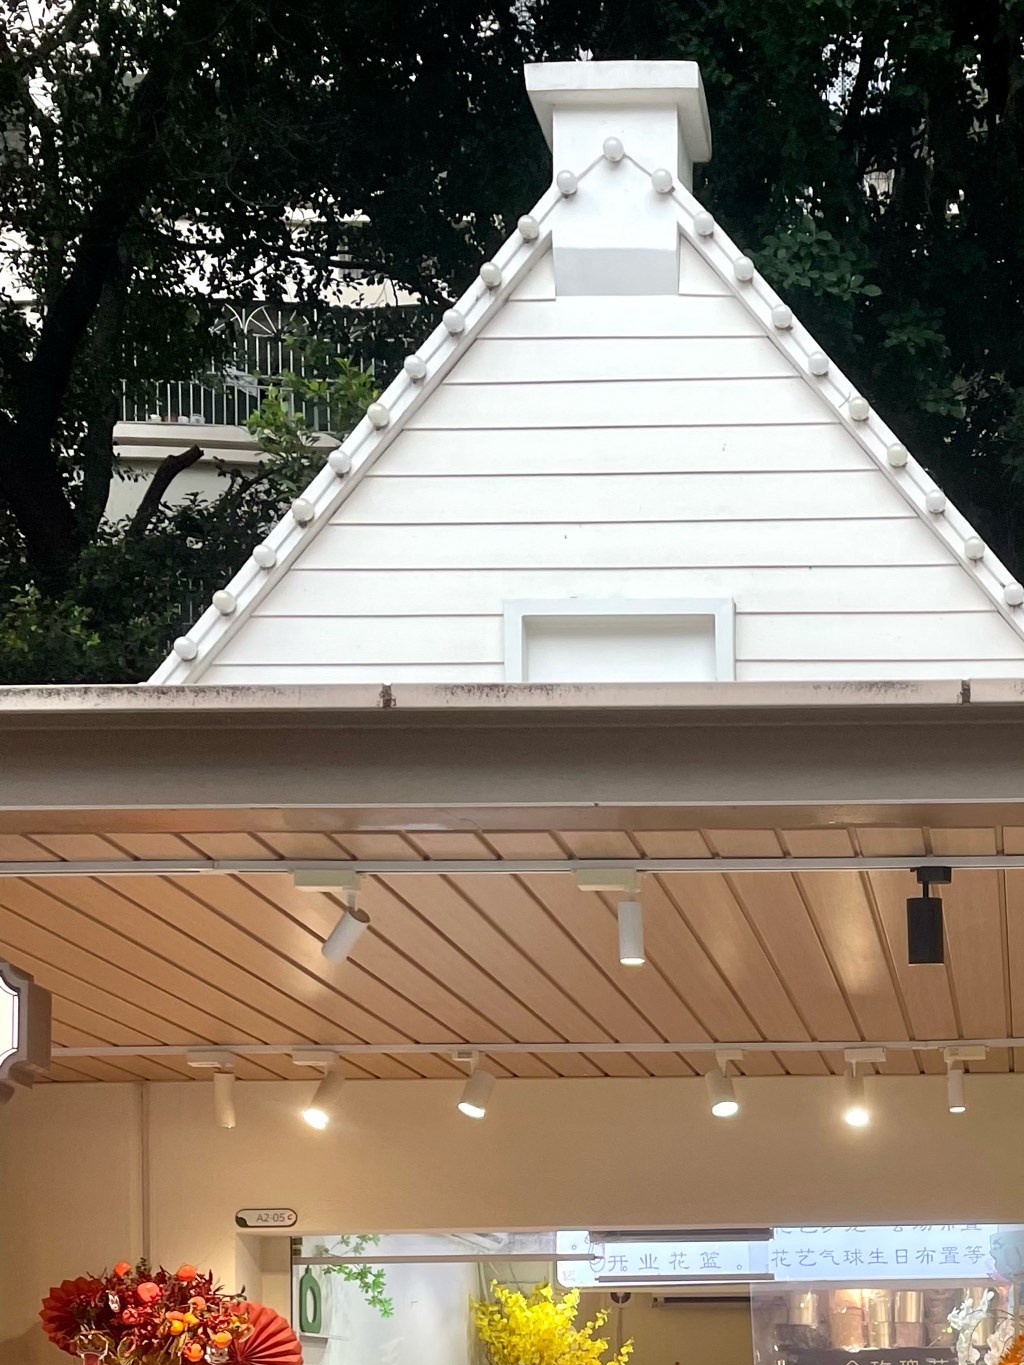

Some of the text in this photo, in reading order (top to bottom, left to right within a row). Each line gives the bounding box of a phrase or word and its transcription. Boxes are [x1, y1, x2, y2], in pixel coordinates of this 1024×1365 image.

[256, 1213, 285, 1222] A2-05
[771, 1246, 986, 1267] 花艺气球生日布置等
